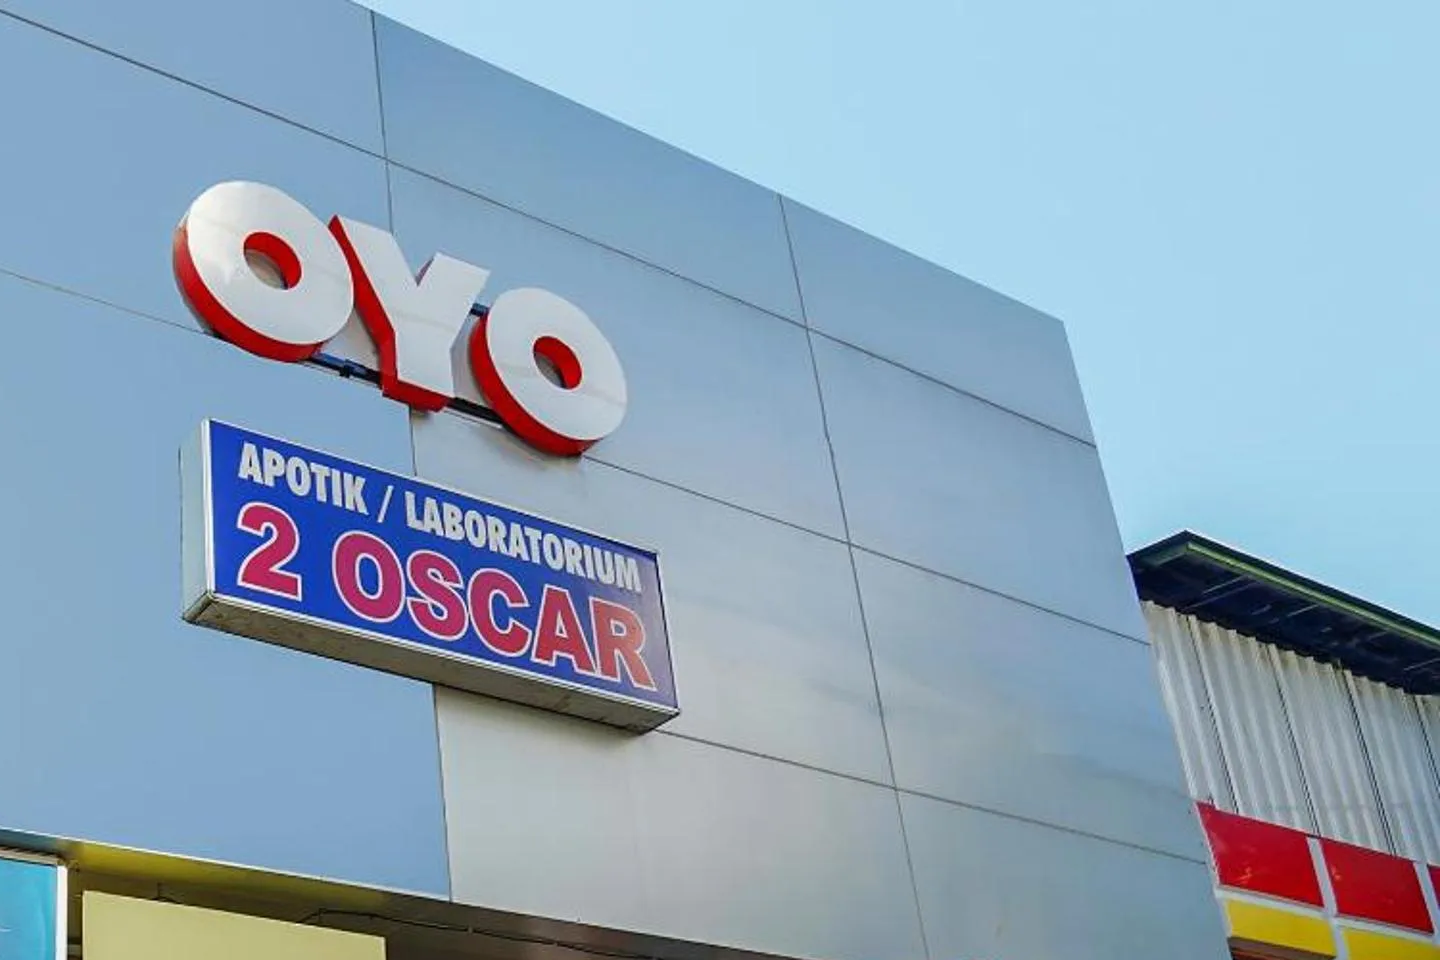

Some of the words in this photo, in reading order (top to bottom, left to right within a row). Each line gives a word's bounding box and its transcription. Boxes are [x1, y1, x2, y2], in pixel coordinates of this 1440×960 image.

[173, 180, 628, 452] OYO
[237, 502, 302, 602] 2
[332, 531, 657, 691] OSCAR
[238, 442, 368, 516] APOTIK
[377, 485, 392, 523] /
[406, 491, 642, 592] LABORATORIUM
